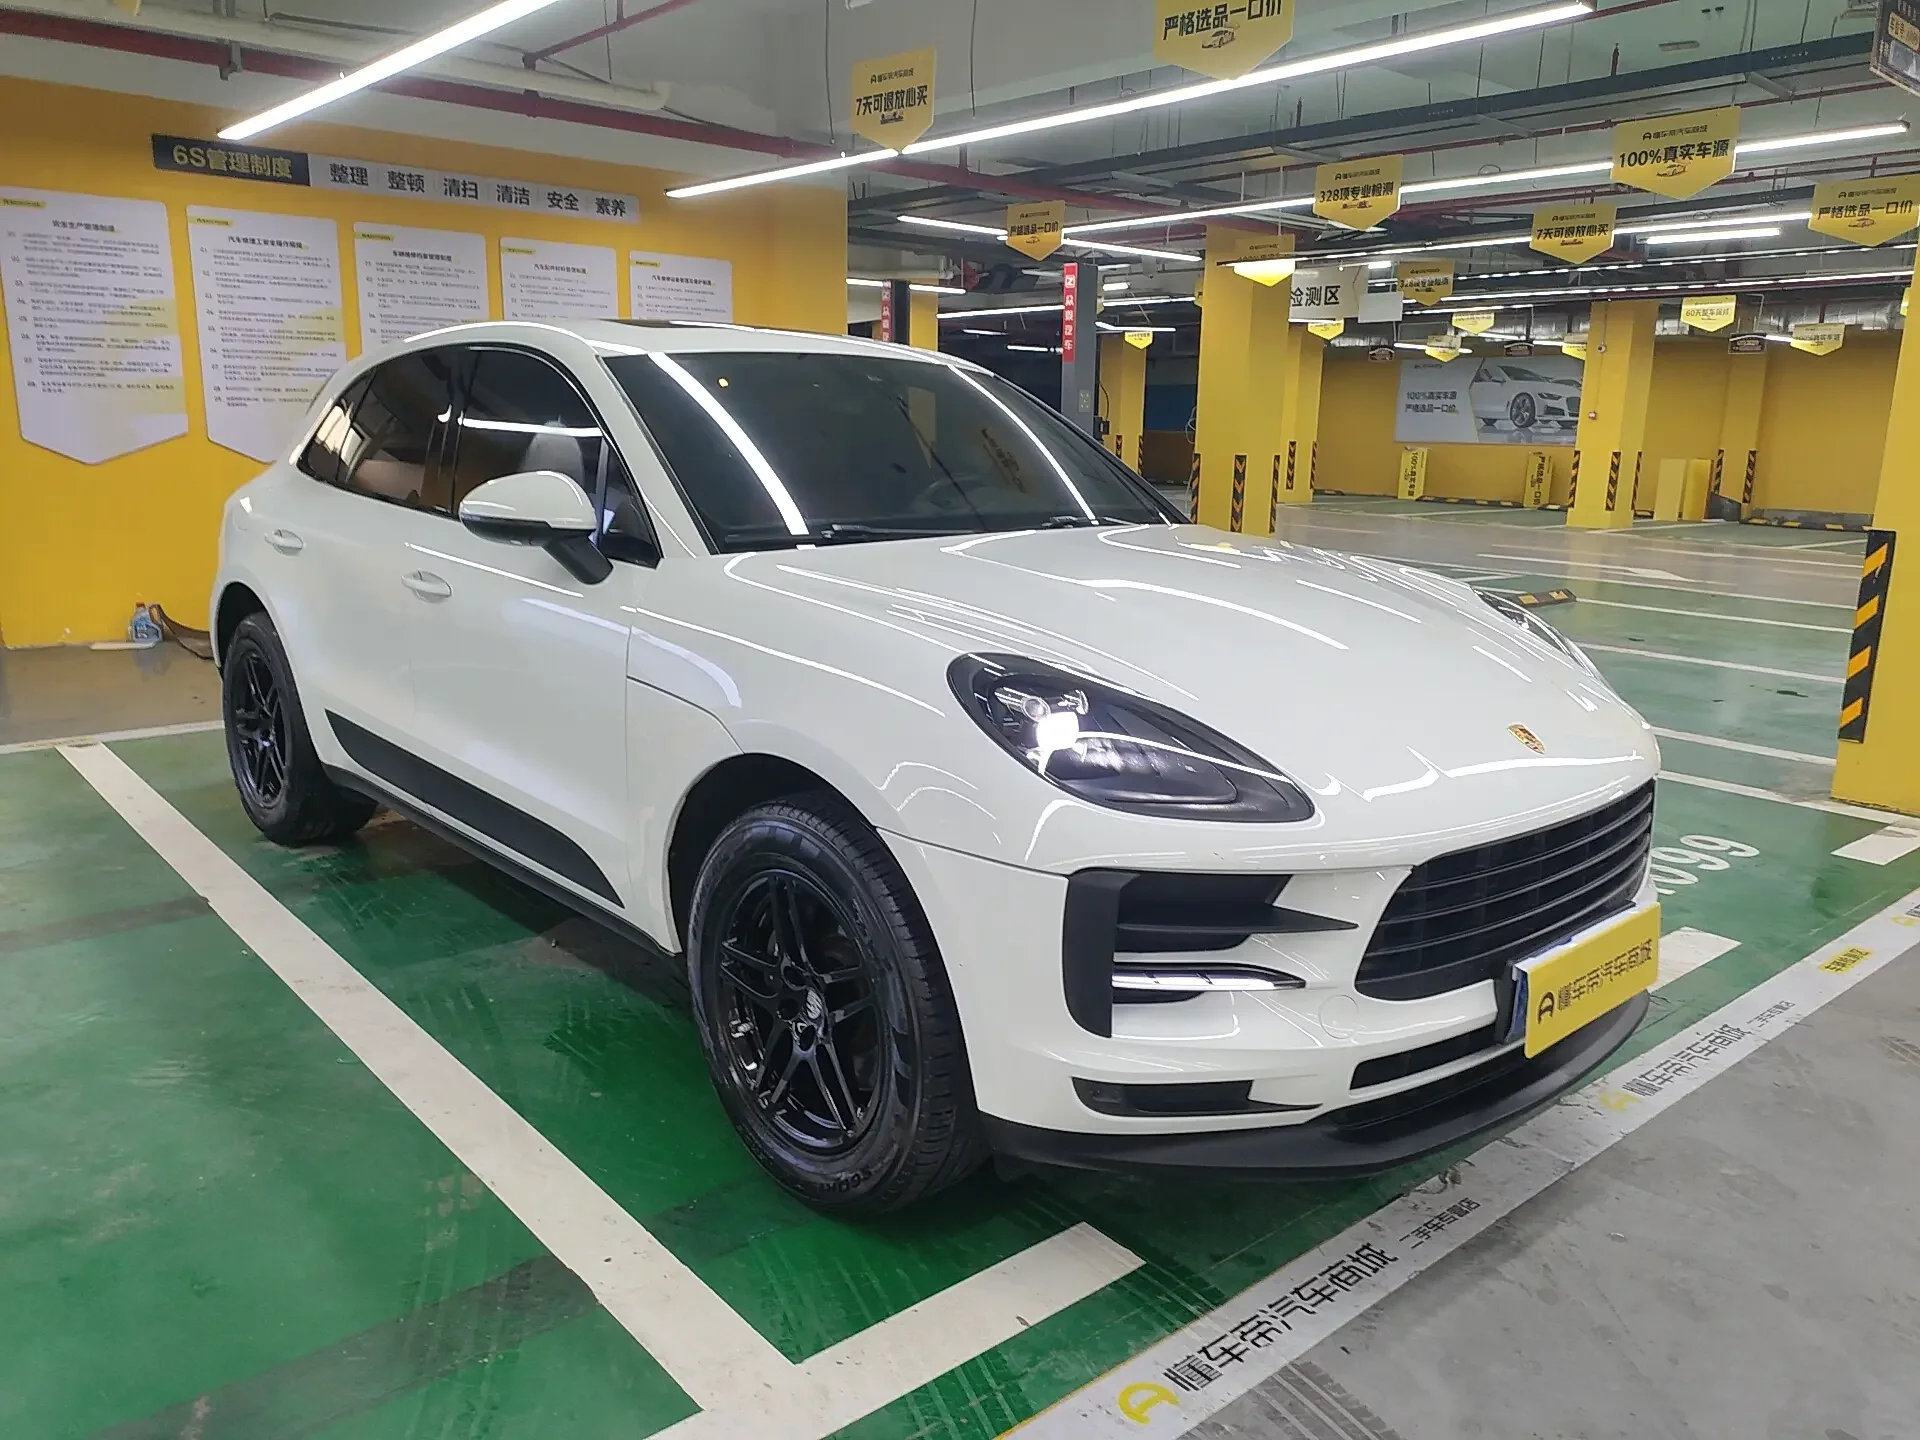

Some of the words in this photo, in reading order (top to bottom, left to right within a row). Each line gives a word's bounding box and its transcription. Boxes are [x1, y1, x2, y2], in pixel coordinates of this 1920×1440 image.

[1163, 0, 1282, 40] 严格选品一口价
[856, 85, 928, 116] 7天可退放心买
[173, 144, 292, 179] 6S管理制度
[1620, 139, 1731, 168] 100%真实车源
[329, 162, 369, 186] 整理
[387, 171, 425, 193] 整顿
[443, 177, 479, 200] 清扫
[496, 184, 530, 206] 清洁
[547, 191, 579, 212] 安全
[595, 197, 627, 217] 素养
[1319, 181, 1394, 203] 328项专业检测
[1818, 200, 1913, 220] 严格选品一口价
[1010, 221, 1059, 237] 严格选品一口价
[1536, 224, 1609, 240] 7天可退放心买
[1649, 834, 1760, 895] 099
[1558, 937, 1653, 1012] 懂车帝汽车商城
[1622, 1024, 1753, 1097] 懂车帝汽车商城
[1162, 1242, 1399, 1392] 懂车帝汽车商城
[1399, 1197, 1481, 1249] 二手车专营店
